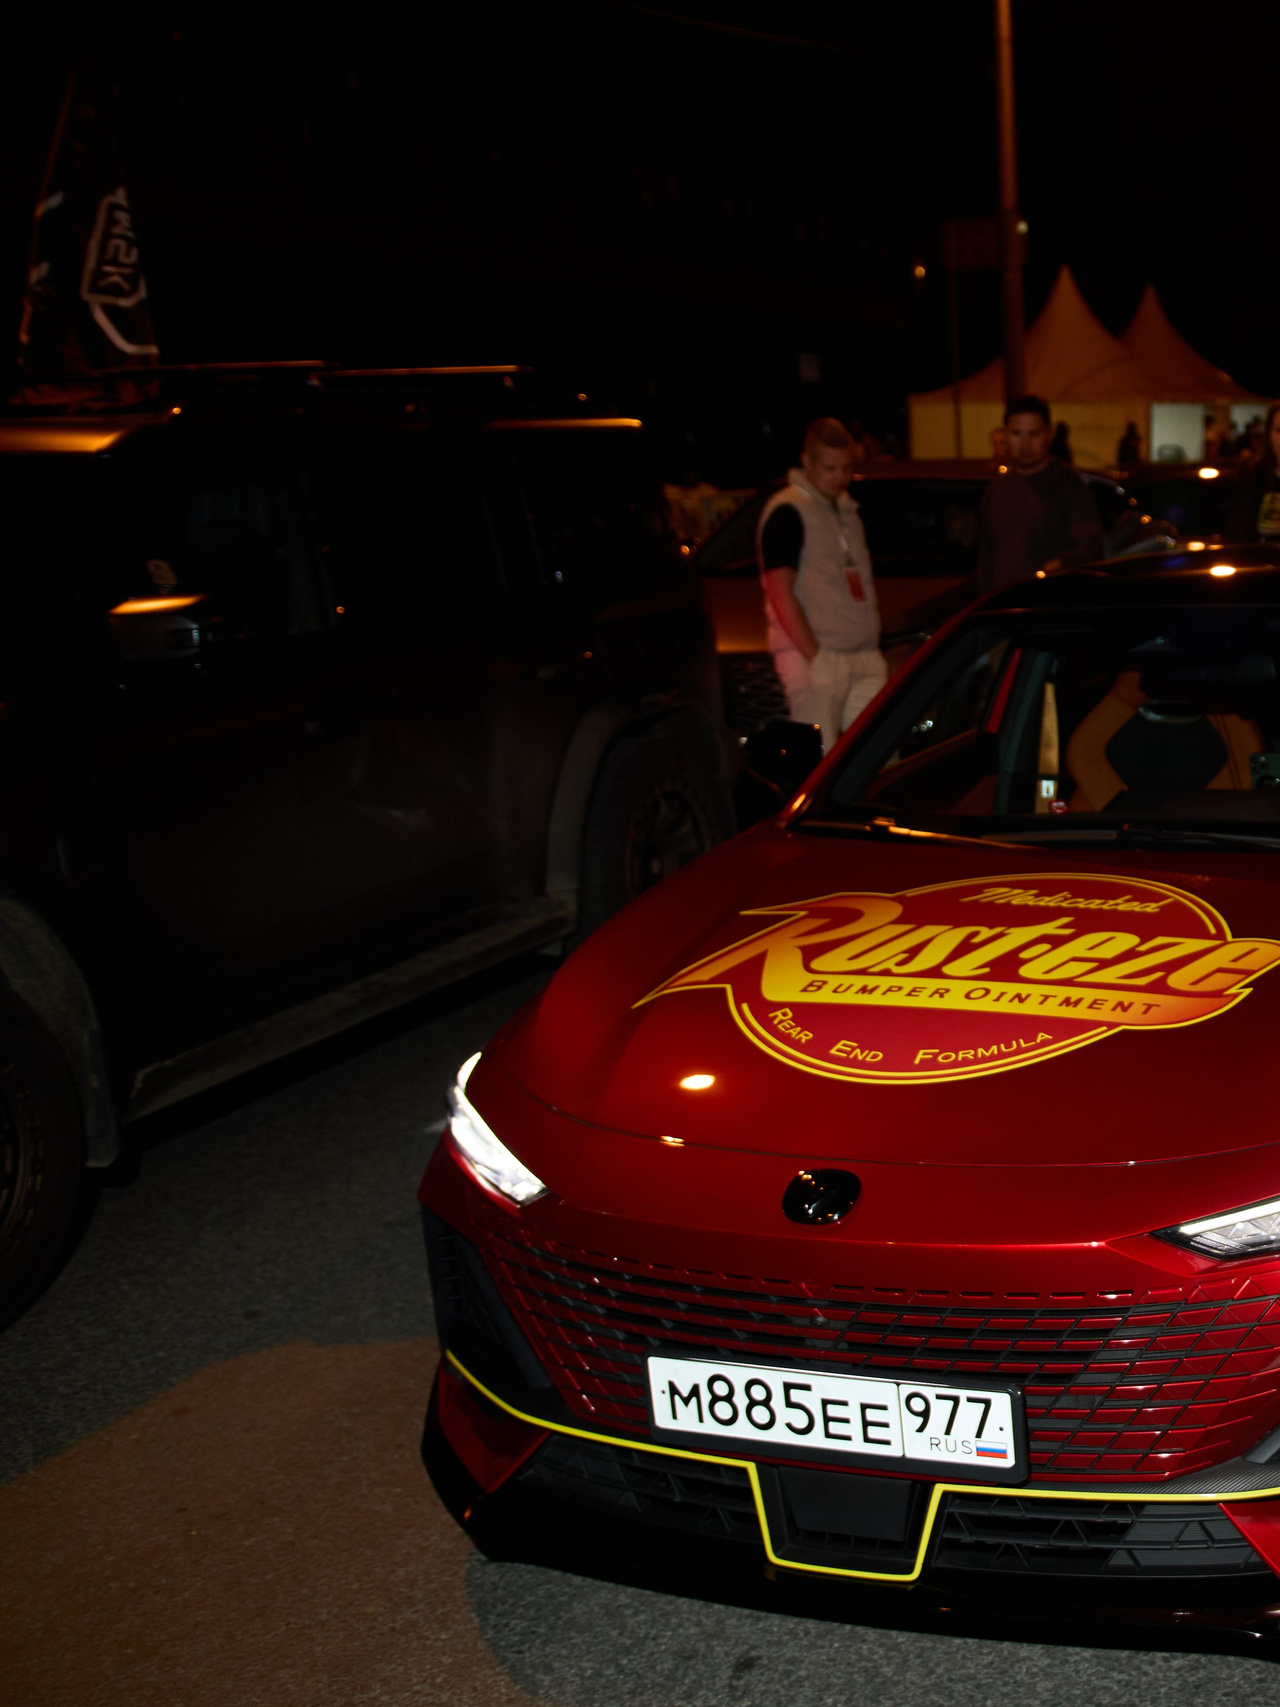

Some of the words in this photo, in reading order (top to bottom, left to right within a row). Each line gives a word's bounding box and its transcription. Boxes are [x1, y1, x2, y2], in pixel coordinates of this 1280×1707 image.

[959, 887, 1176, 913] Medicated
[799, 980, 952, 999] BUMPER
[964, 987, 1161, 1015] OINTMENT
[768, 1007, 814, 1043] REAR
[829, 1040, 884, 1063] END
[913, 1032, 1054, 1065] FORMULA
[904, 1390, 993, 1439] 977
[929, 1437, 973, 1456] RUS
